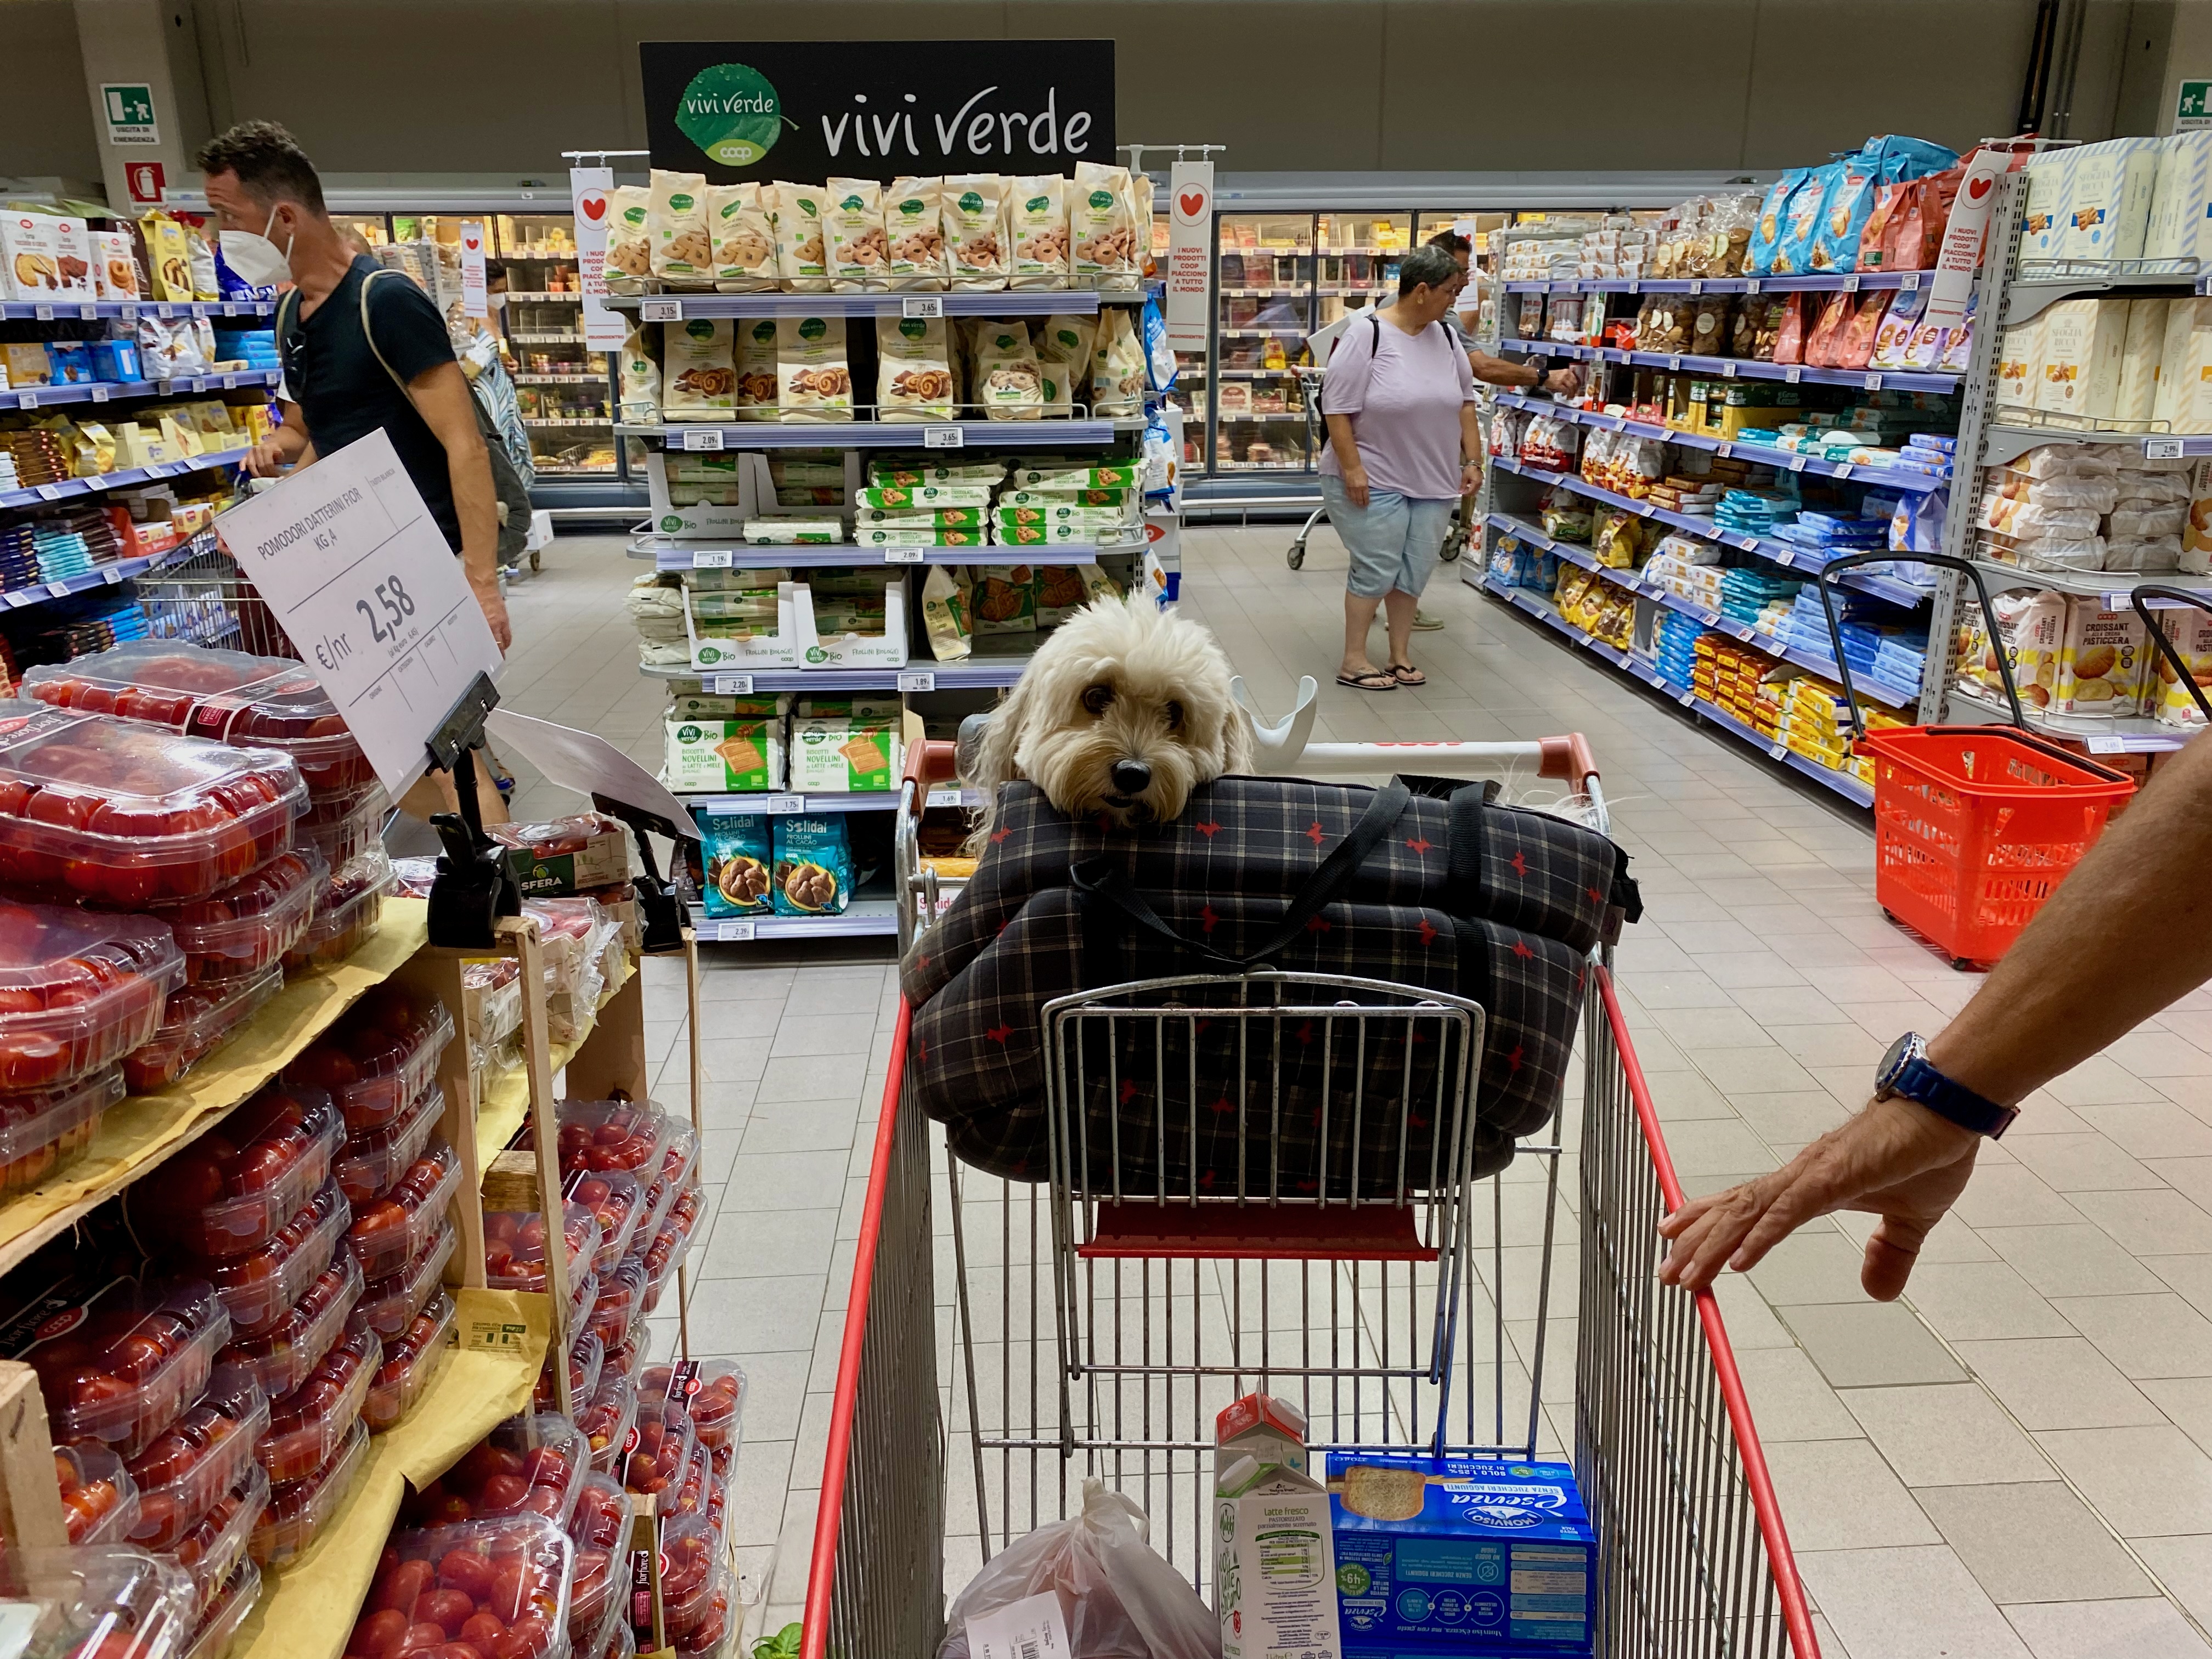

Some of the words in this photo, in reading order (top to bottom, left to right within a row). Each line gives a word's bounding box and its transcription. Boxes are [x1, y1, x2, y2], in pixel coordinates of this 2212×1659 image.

[687, 93, 719, 114] vivi
[723, 91, 774, 113] verde
[822, 94, 919, 156] vivi
[935, 86, 1091, 155] verde
[720, 147, 752, 160] coop
[1949, 234, 1978, 242] PRODOTTI
[1944, 249, 1976, 257] PIACCIONO
[257, 518, 308, 560] POMODORI
[306, 494, 347, 531] DATTERINI
[342, 487, 364, 509] FIOR
[314, 534, 329, 551] KG
[357, 575, 415, 645] 2,58
[2048, 616, 2057, 645] PASTICCERA
[2085, 623, 2129, 631] CROISSANT
[2083, 637, 2129, 645] PASTICCERA
[315, 630, 352, 671] €/nr
[723, 652, 735, 661] Bio
[830, 652, 842, 661] Bio
[704, 730, 718, 740] Bio
[713, 815, 754, 830] Solidal
[786, 819, 827, 833] Solidal
[521, 877, 562, 890] SFERA
[44, 1314, 72, 1333] coop
[1446, 1483, 1485, 1492] AGGIUNTI
[1487, 1485, 1529, 1493] ZUCCHERI
[1532, 1486, 1559, 1494] SENZA
[1265, 1508, 1283, 1516] latte
[1285, 1507, 1308, 1516] fresco
[1472, 1516, 1535, 1528] MONVISO
